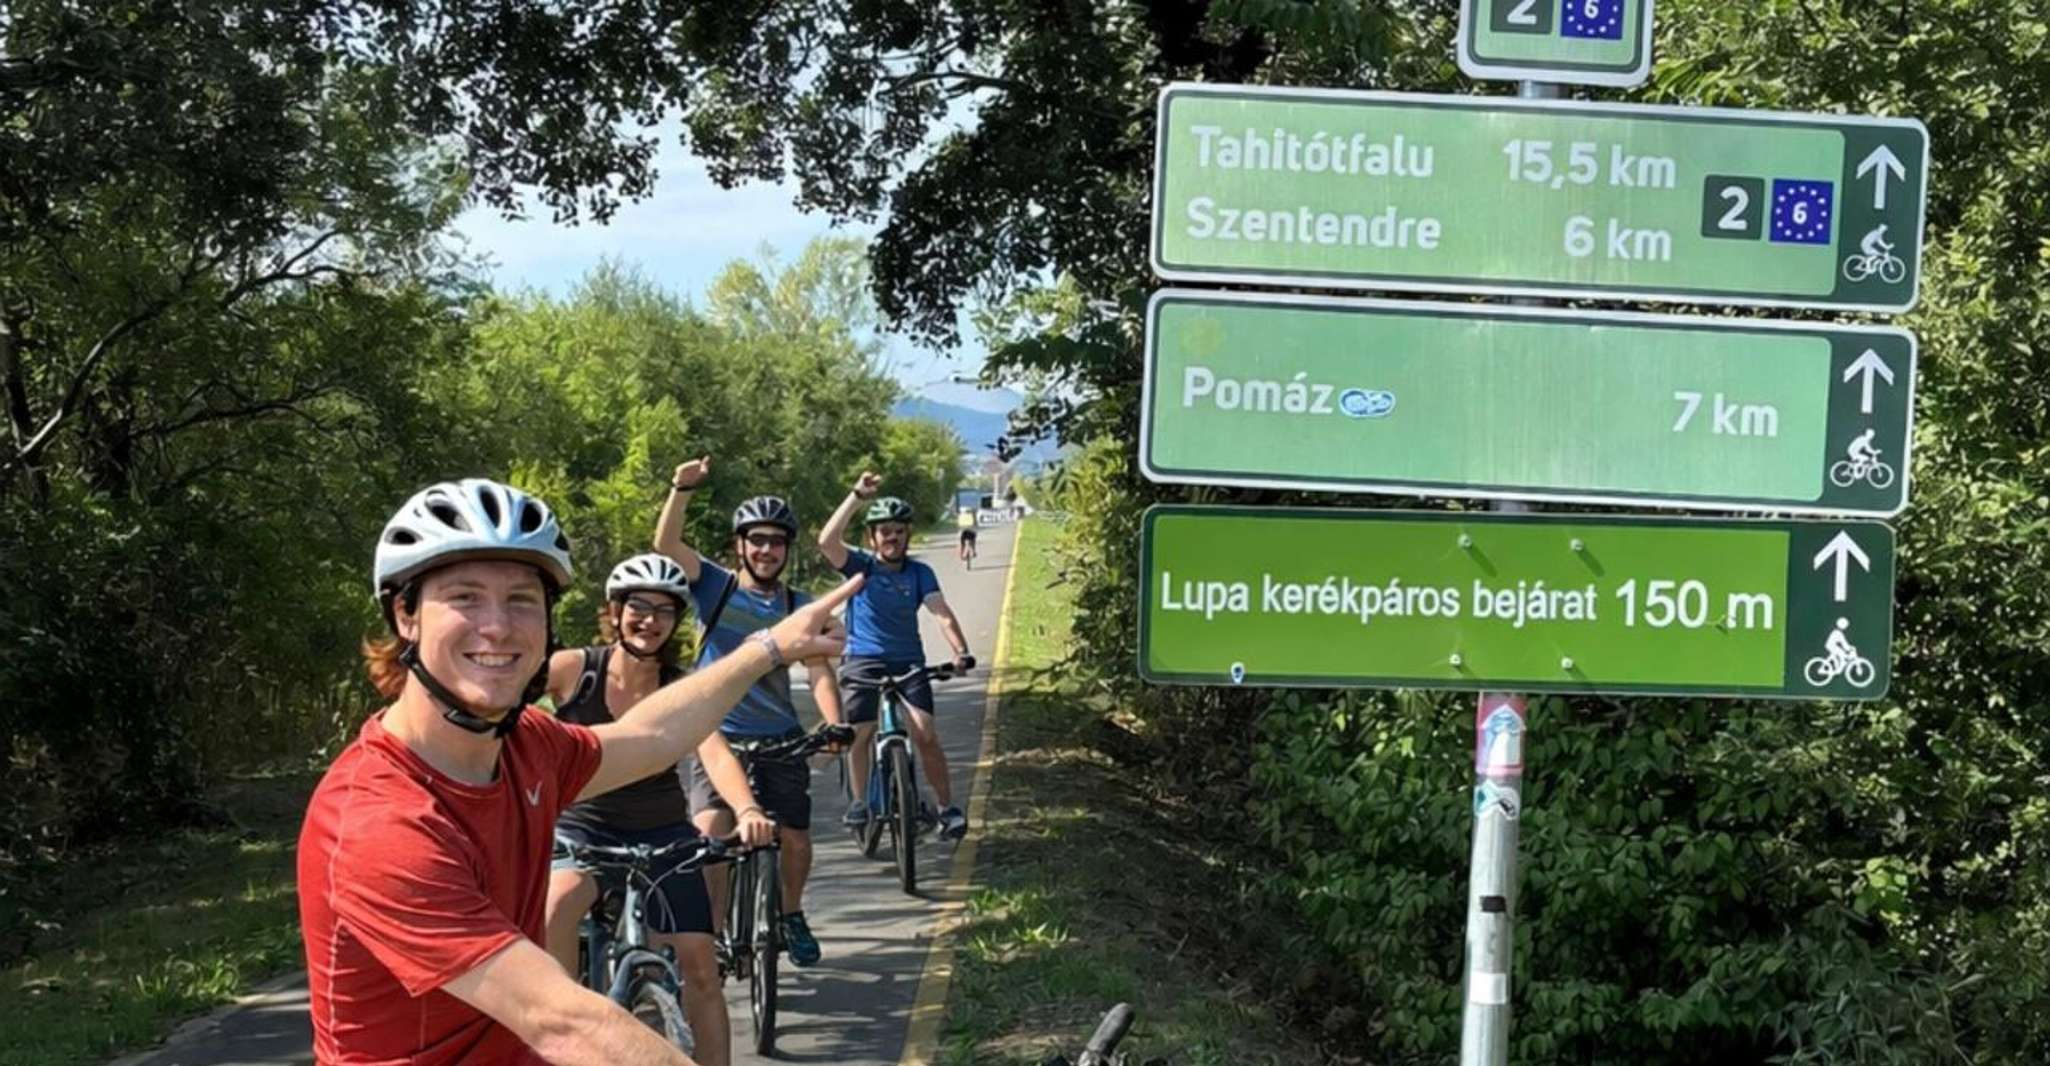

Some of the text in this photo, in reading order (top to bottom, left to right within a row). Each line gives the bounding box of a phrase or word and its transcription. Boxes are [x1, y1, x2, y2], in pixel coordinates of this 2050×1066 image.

[1583, 0, 1600, 19] 6
[1190, 126, 1677, 188] Tahitótfalu 15,5 km
[1187, 196, 1673, 261] Szentendre 6 km
[1718, 185, 1808, 231] 2 6
[1182, 367, 1334, 416] Pomáz
[1673, 391, 1700, 432] 7
[1713, 397, 1779, 437] km
[1161, 572, 1774, 629] Lupa kerékpáros bejárat 150 m
